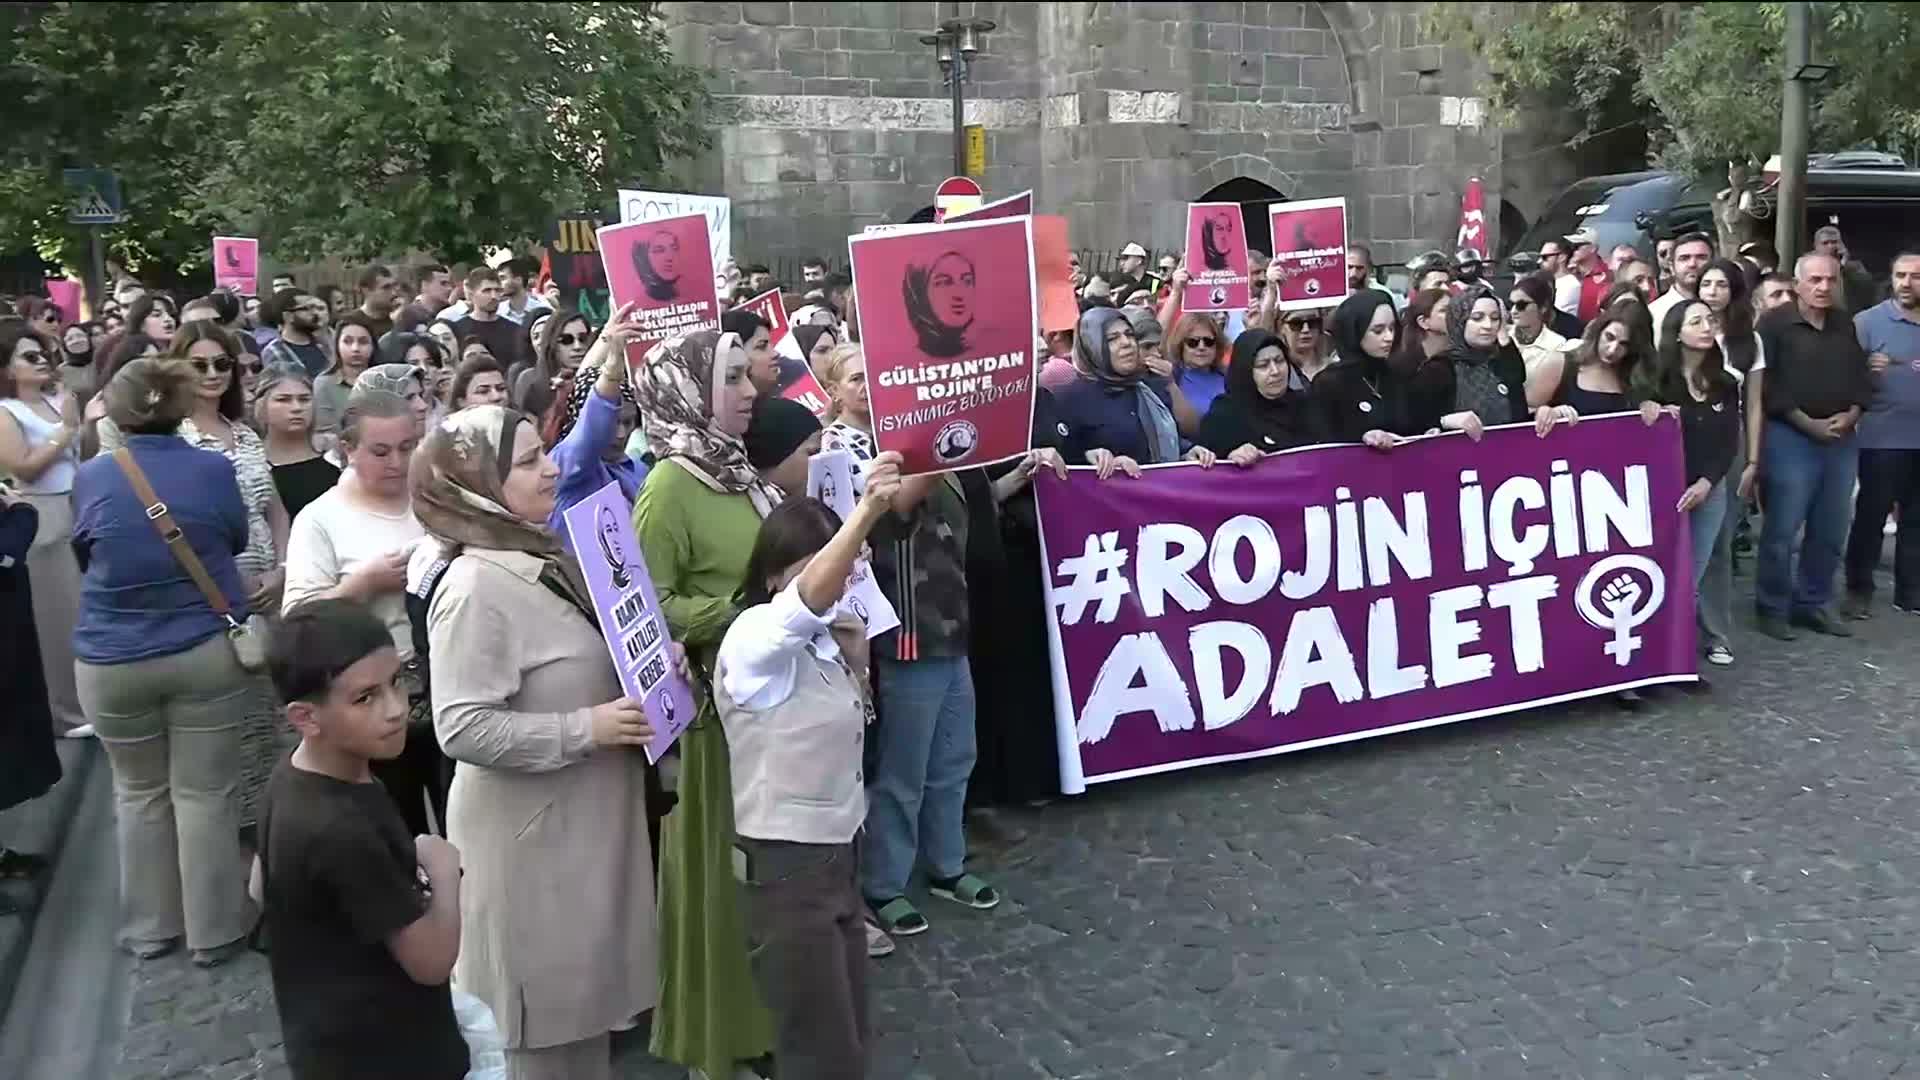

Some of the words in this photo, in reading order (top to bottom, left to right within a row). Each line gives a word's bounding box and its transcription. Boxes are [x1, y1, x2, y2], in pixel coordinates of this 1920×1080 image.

[879, 352, 1024, 386] GÜLİSTAN'DAN
[917, 376, 993, 401] ROJİN'E
[880, 401, 956, 432] İSYANIMIZ
[1053, 485, 1432, 625] #ROJİN
[1460, 459, 1654, 576] İÇİN
[1078, 575, 1560, 745] ADALET
